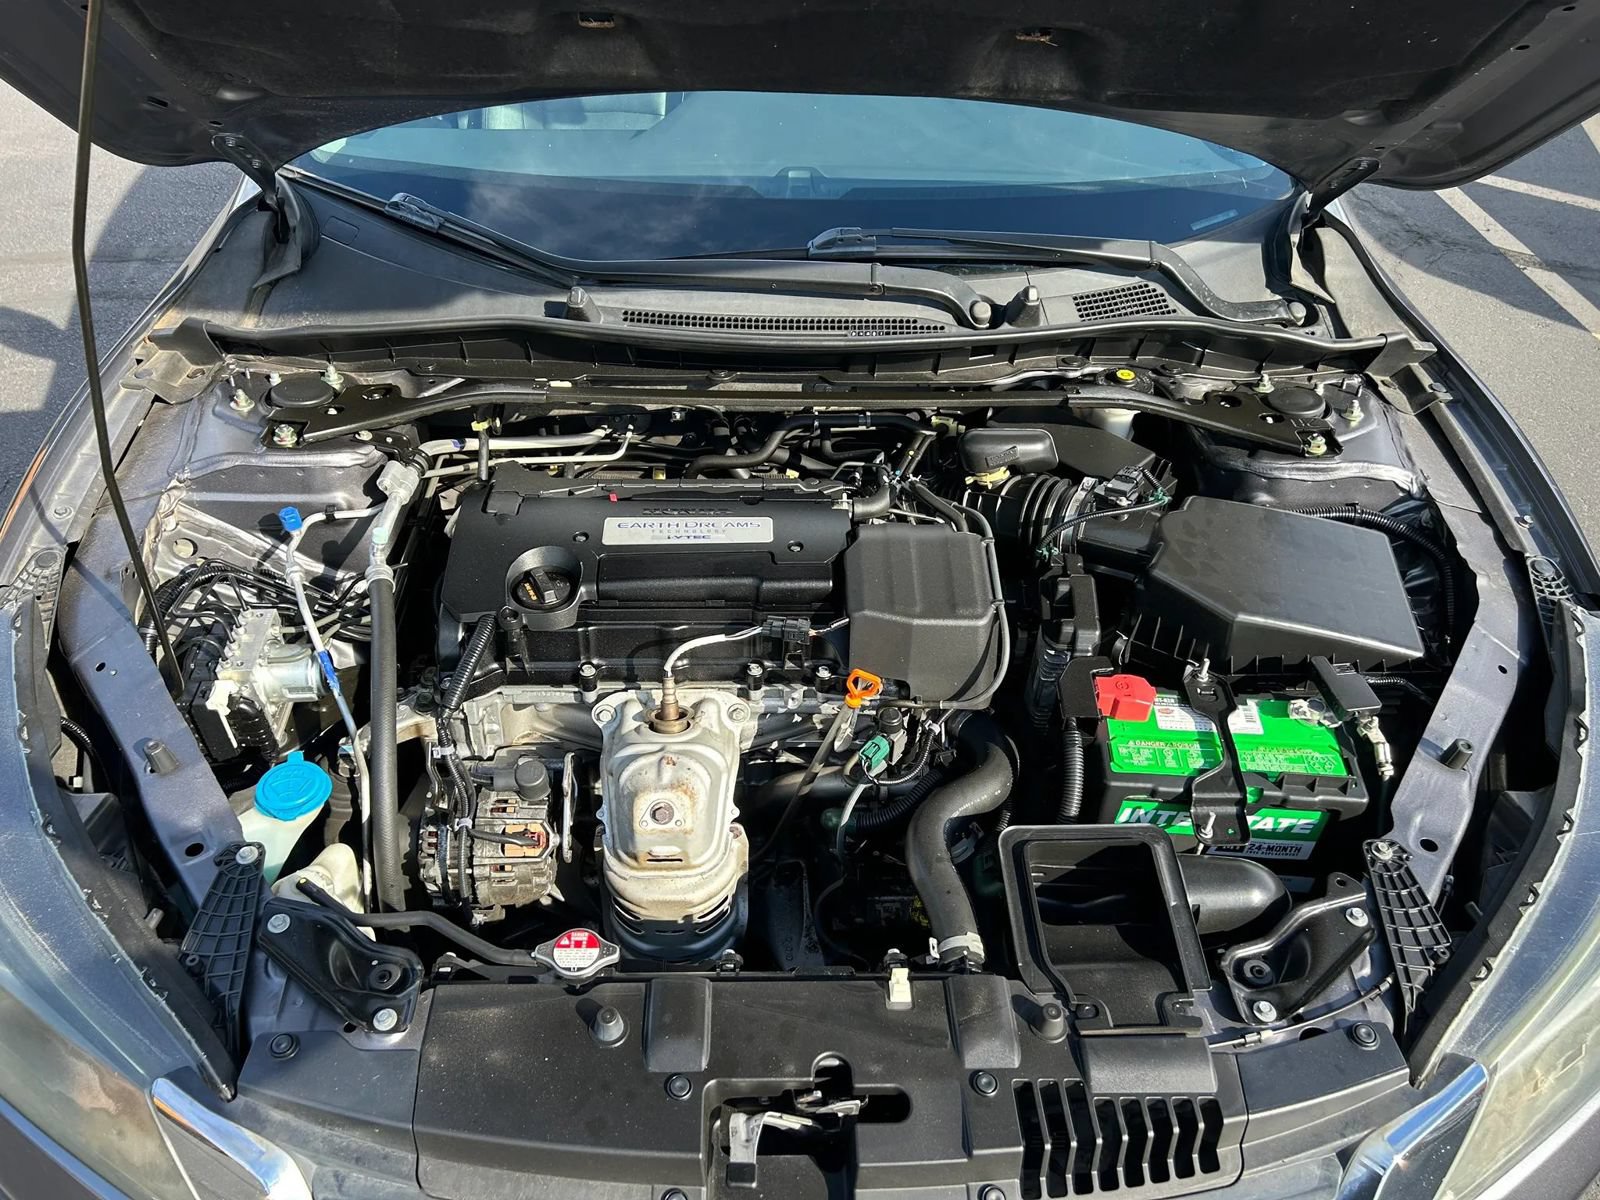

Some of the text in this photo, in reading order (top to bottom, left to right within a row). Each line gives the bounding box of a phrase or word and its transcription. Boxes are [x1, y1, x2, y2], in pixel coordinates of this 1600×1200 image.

[617, 521, 680, 529] EARTH
[1119, 807, 1319, 834] INTETATE
[1248, 843, 1303, 853] 24-MONTH
